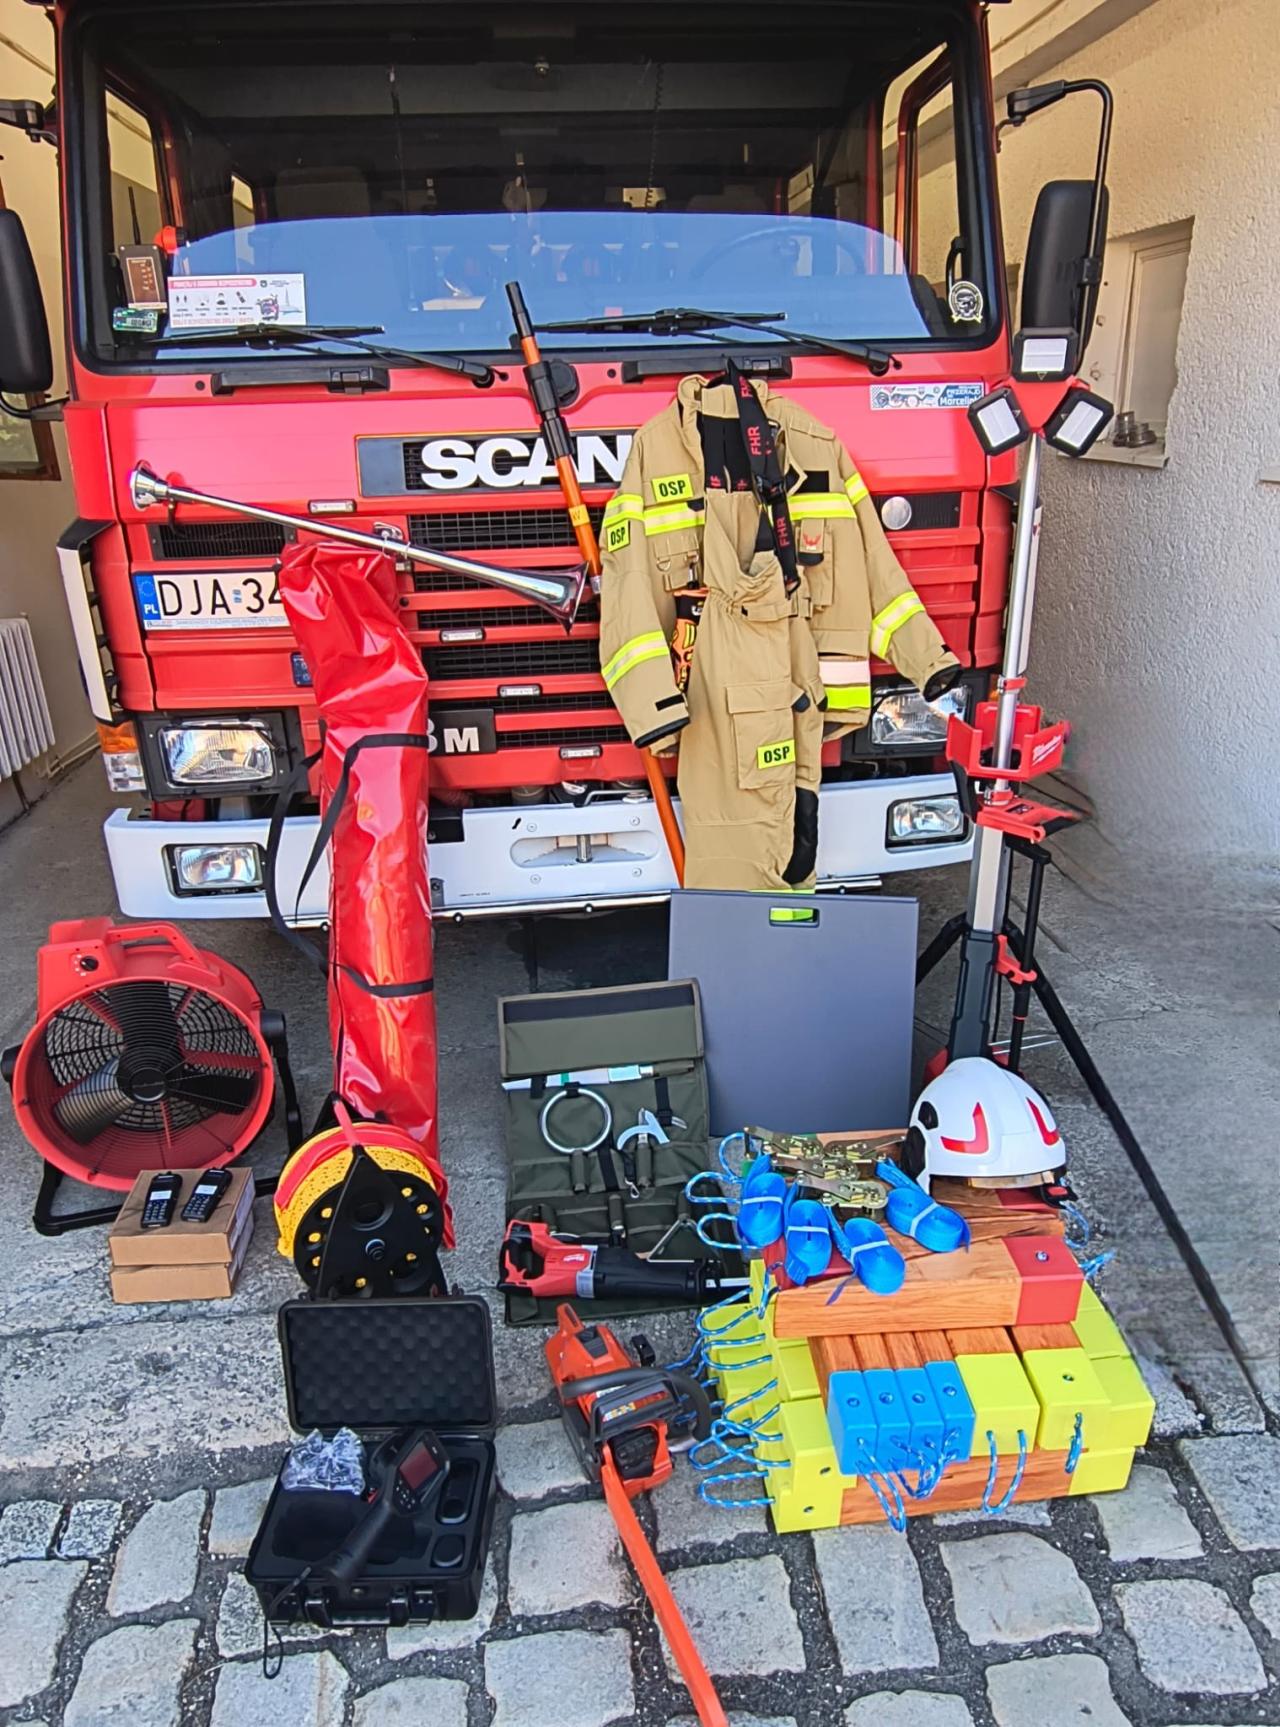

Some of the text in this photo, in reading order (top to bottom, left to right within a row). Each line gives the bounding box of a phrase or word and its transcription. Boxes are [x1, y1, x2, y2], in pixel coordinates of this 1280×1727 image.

[747, 426, 762, 456] FHR
[658, 479, 686, 497] OSP
[610, 526, 626, 546] OSP
[776, 517, 790, 547] FHR
[158, 578, 232, 617] DJA
[144, 604, 159, 615] PL
[763, 745, 790, 764] OSP
